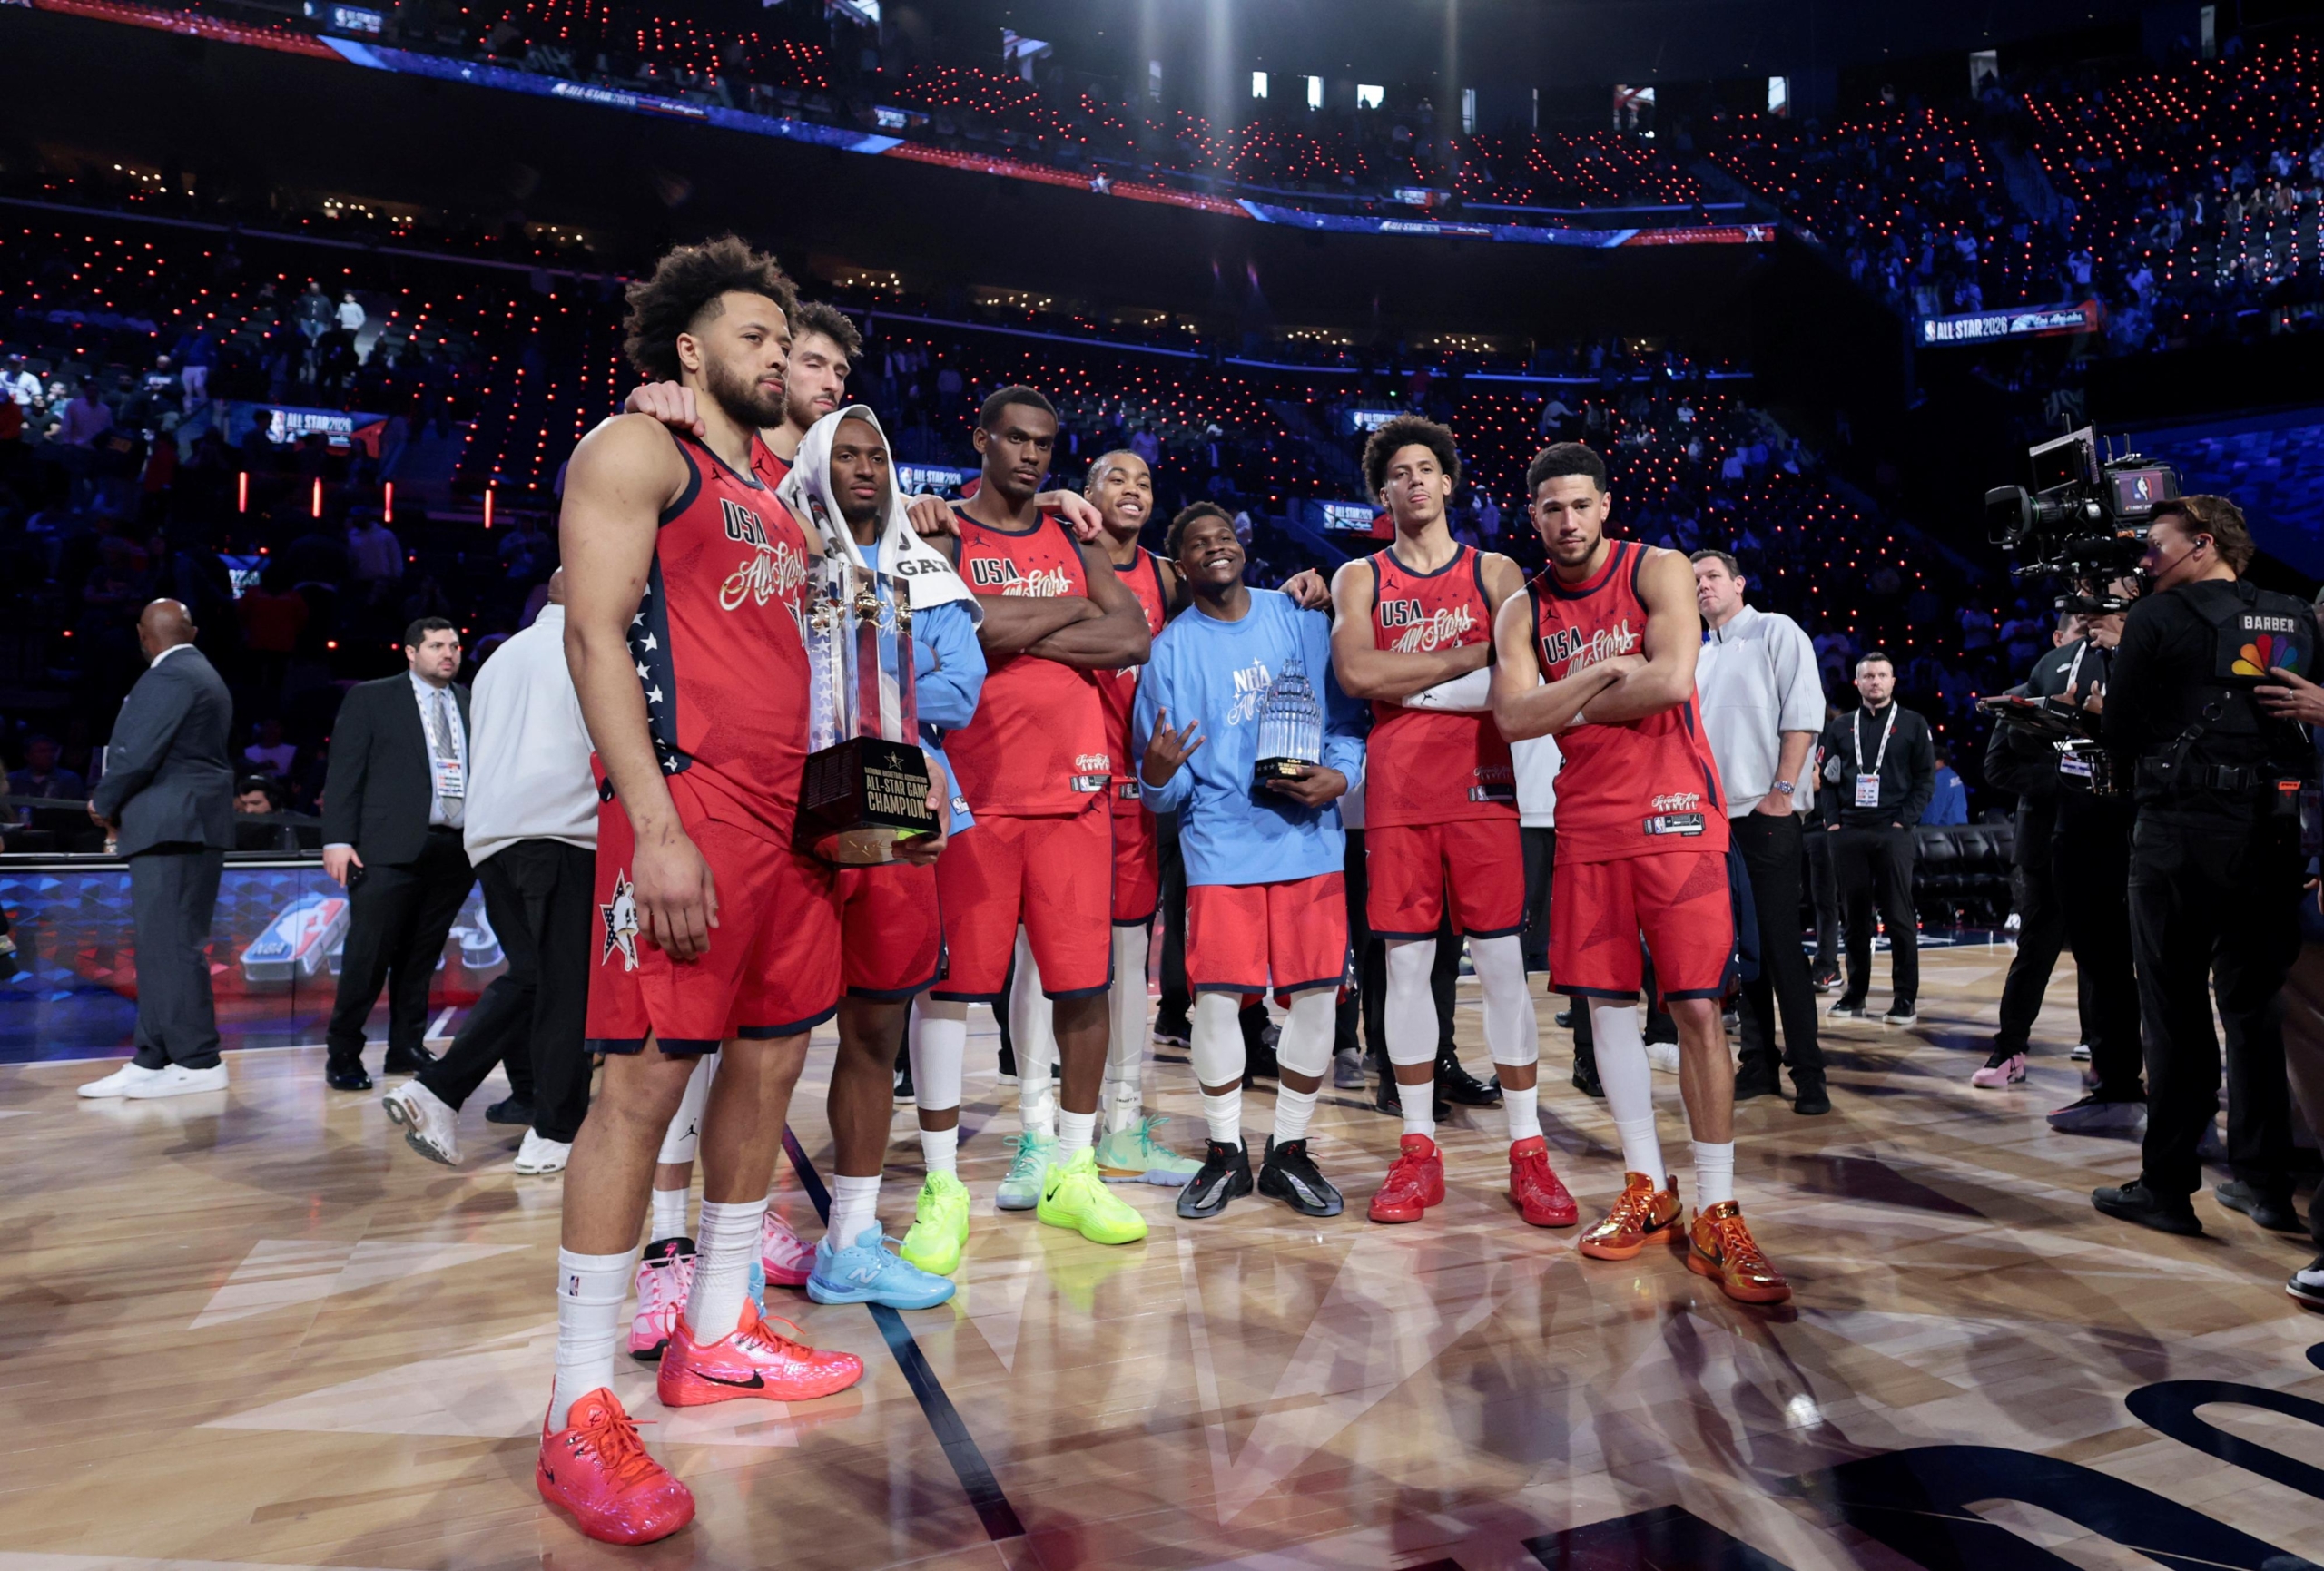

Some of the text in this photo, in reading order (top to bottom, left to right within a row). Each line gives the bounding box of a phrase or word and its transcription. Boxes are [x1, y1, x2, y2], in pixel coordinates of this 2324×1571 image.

[1983, 316, 2008, 337] 2026
[719, 497, 771, 554] USA
[970, 557, 1024, 586] USA
[1380, 598, 1424, 628] USA
[2244, 615, 2294, 633] BARBER
[1541, 625, 1584, 665] USA
[1233, 664, 1272, 692] NBA
[866, 775, 906, 796] ALL-STAR
[1659, 801, 1697, 812] ANNUAL
[255, 942, 286, 955] NBA
